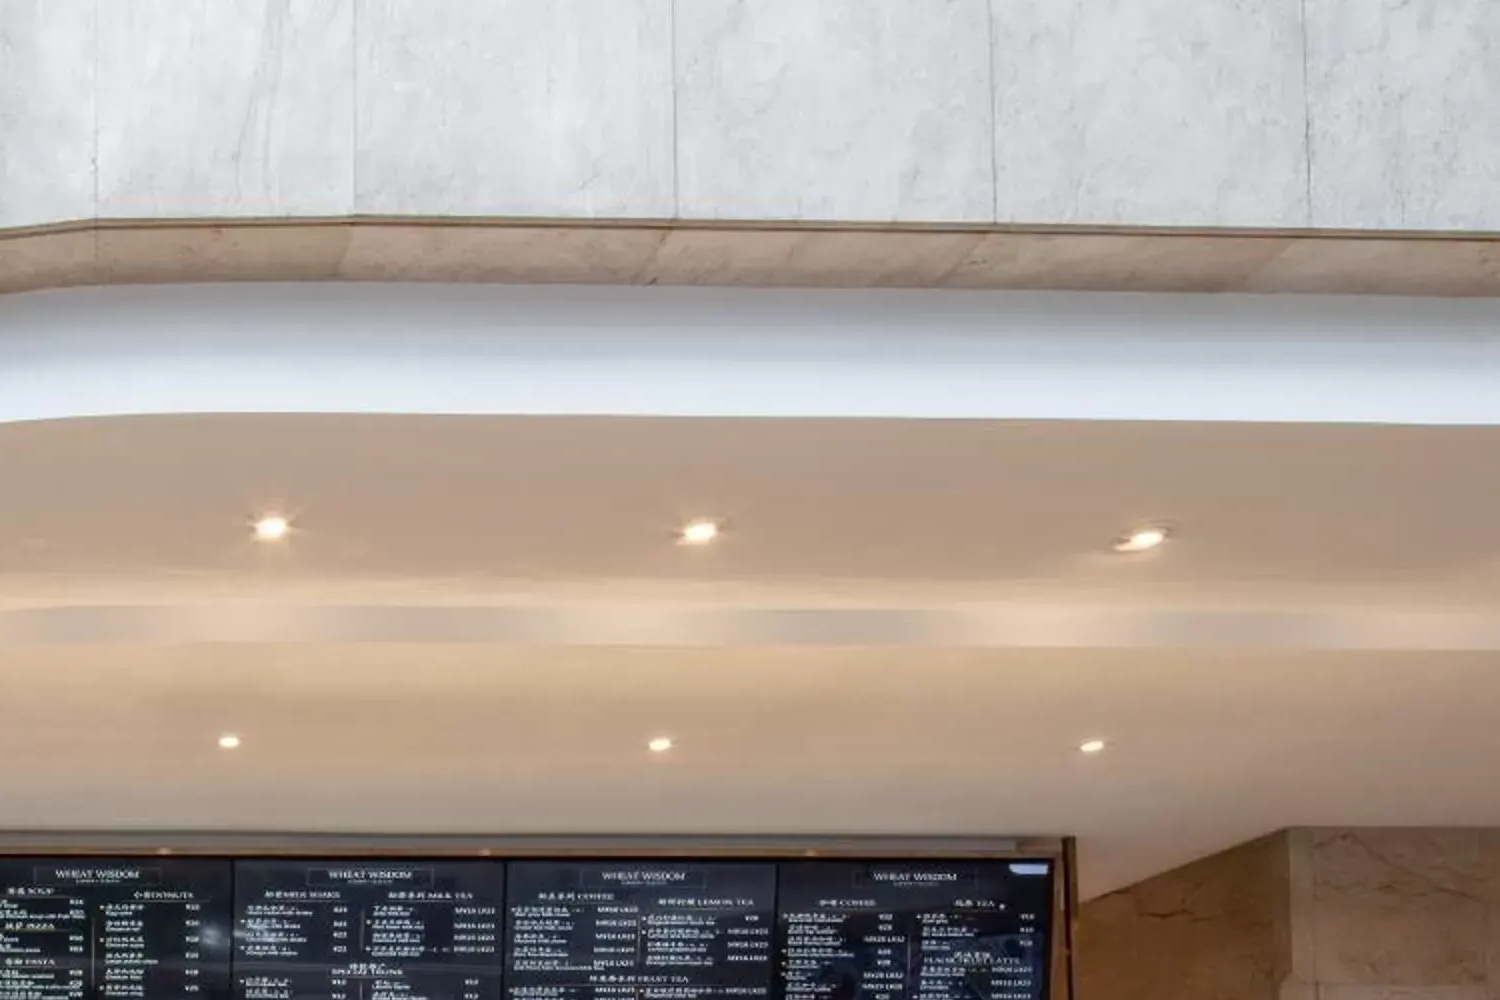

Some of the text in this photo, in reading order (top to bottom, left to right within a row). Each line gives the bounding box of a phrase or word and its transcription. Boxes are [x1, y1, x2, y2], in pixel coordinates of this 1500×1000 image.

[55, 869, 140, 879] WHEAT WISDOM
[329, 871, 412, 879] WHEAT WISDOM
[602, 871, 685, 880] WHEAT WISDOM
[873, 873, 957, 881] WHEAT WISDOM
